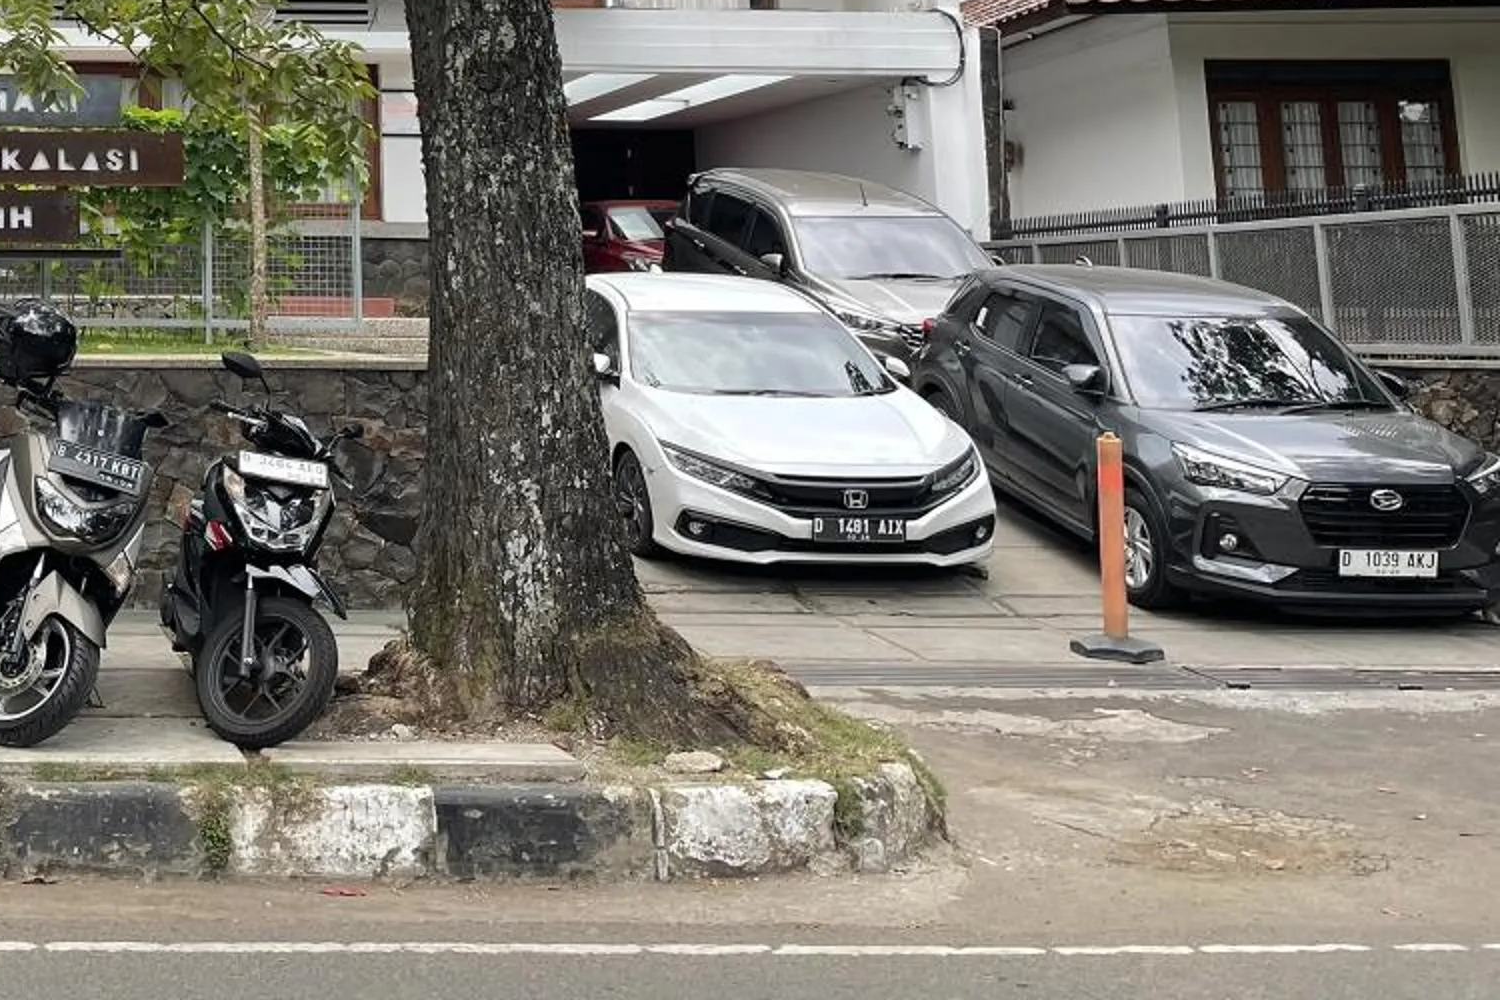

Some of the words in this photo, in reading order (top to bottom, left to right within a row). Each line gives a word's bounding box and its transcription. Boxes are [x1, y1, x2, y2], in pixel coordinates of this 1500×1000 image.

[814, 517, 824, 534] D
[838, 518, 870, 535] 1481
[877, 519, 904, 535] AIX
[1342, 551, 1351, 567] D
[1366, 551, 1400, 567] 1039
[1406, 553, 1436, 568] AKJ
